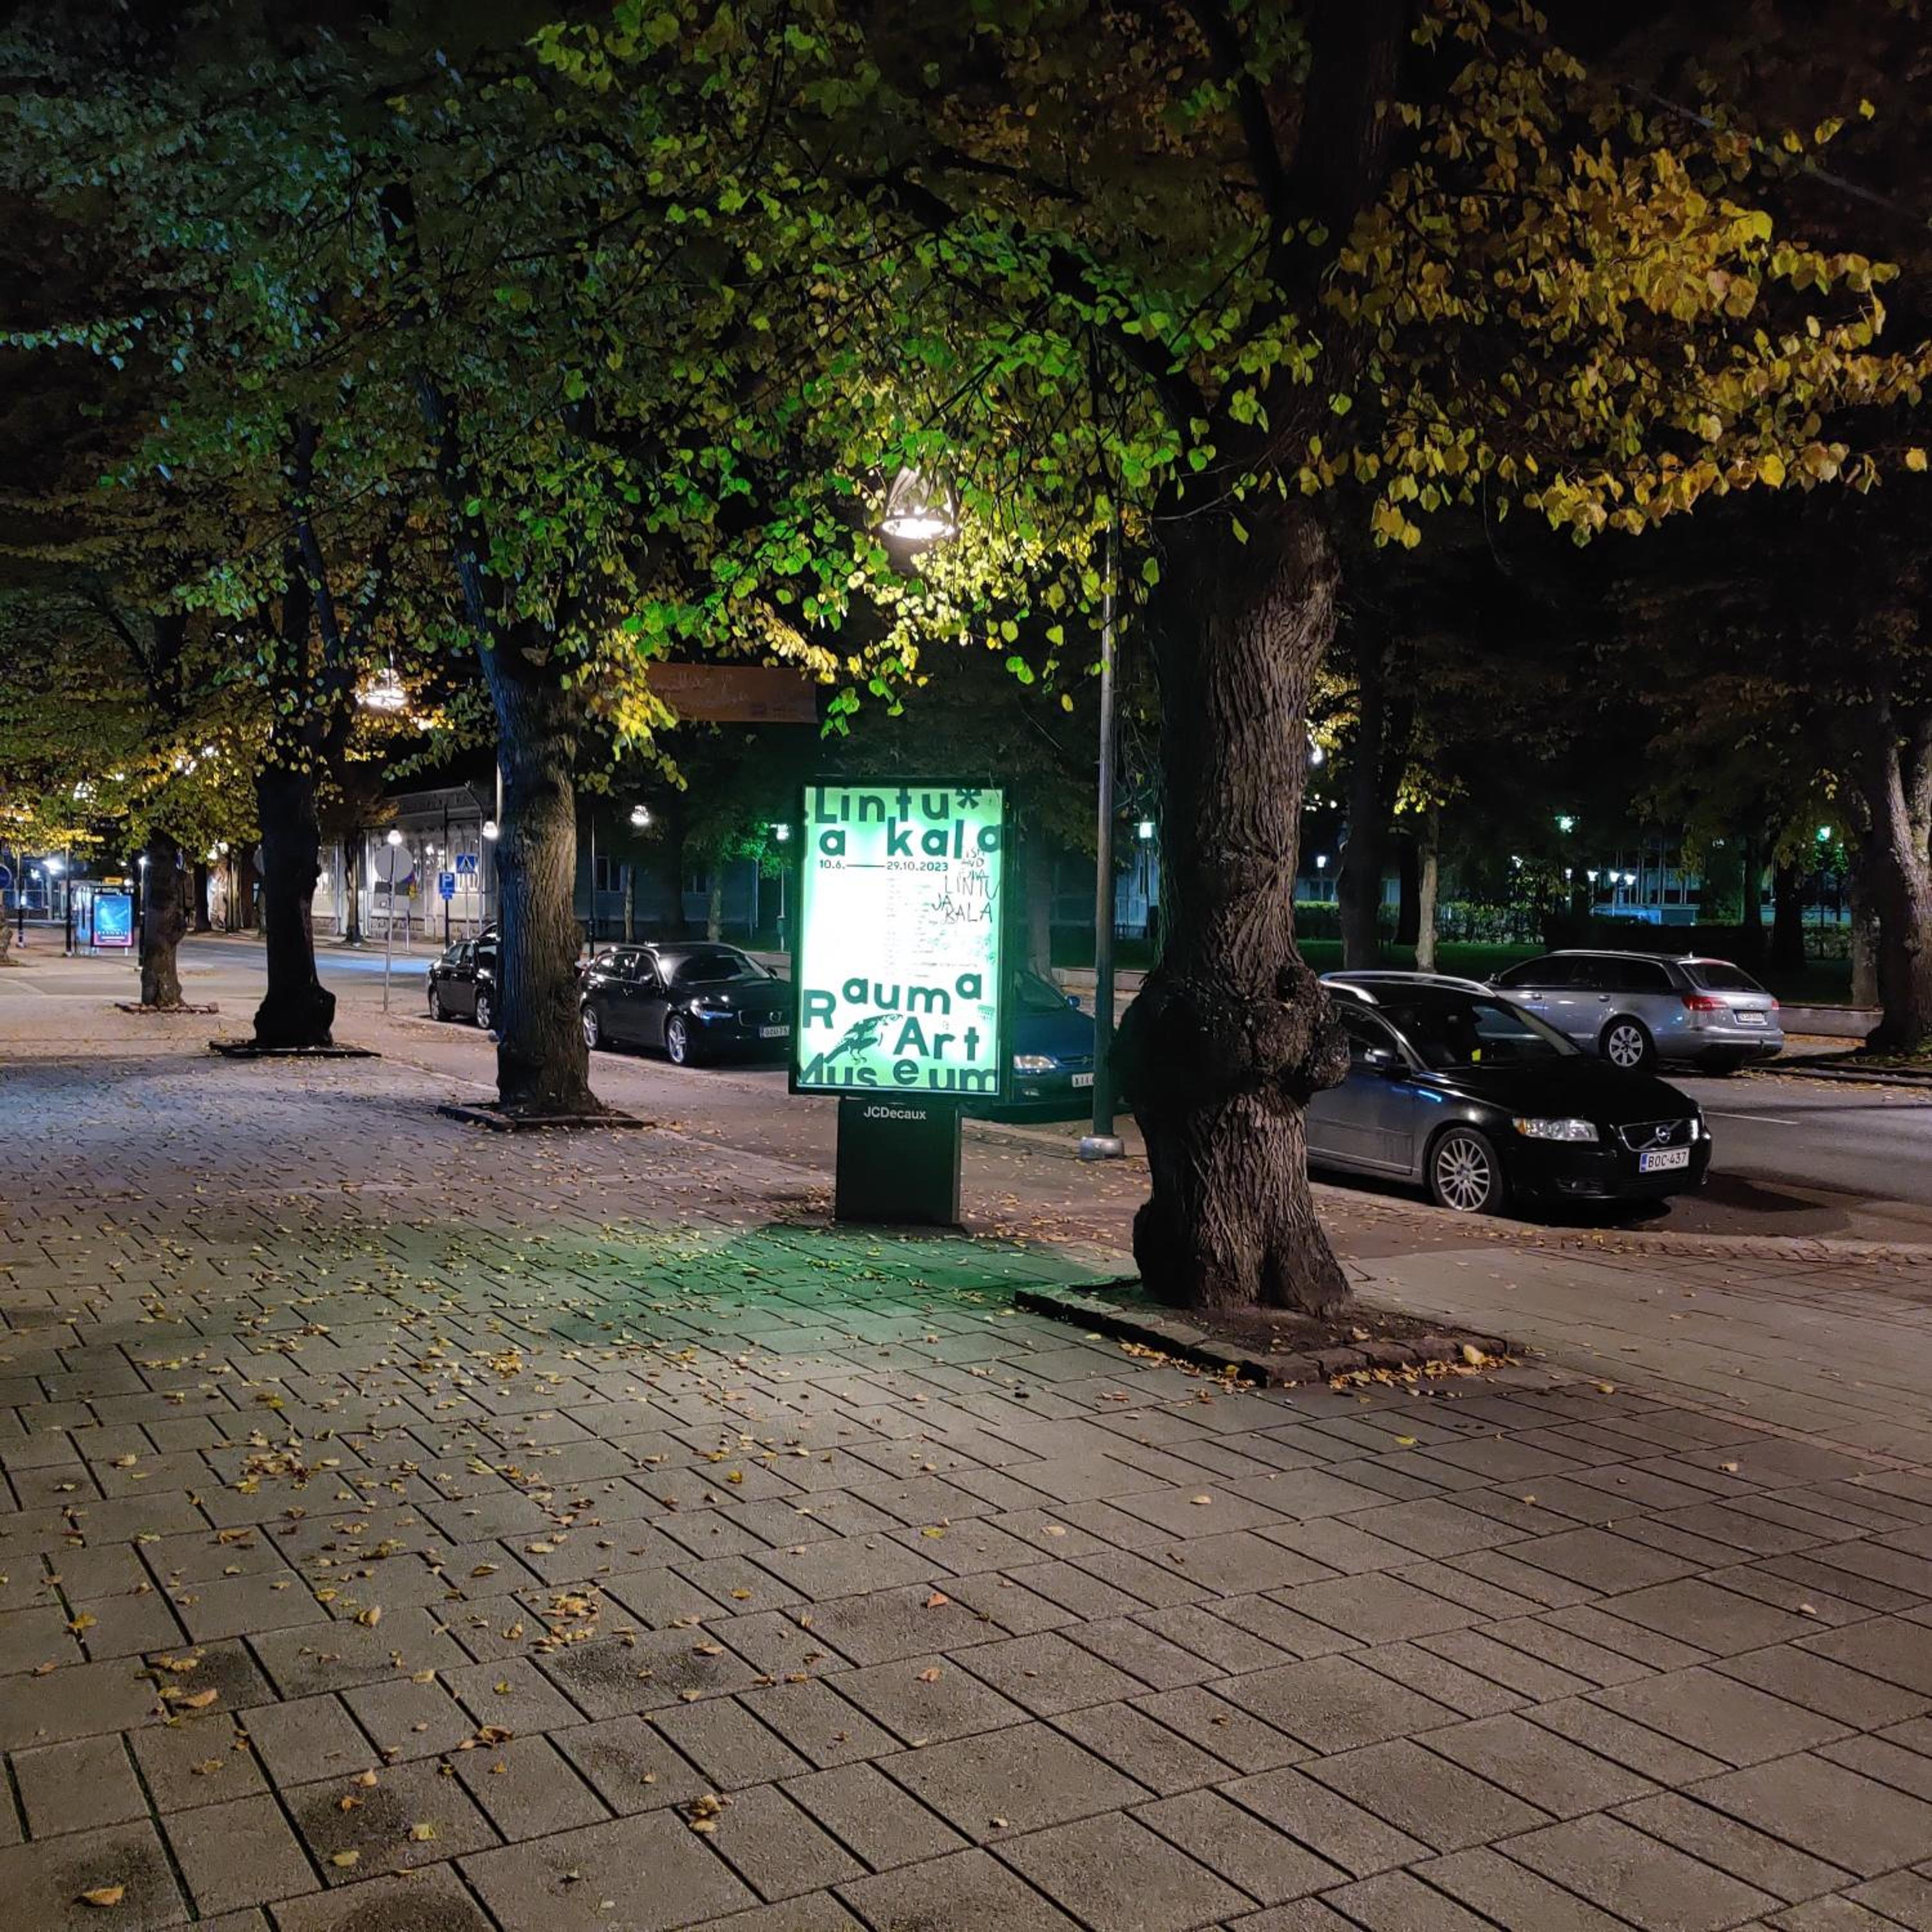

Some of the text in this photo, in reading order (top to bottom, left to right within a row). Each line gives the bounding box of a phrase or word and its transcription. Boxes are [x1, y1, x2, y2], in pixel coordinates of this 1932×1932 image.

[442, 874, 453, 887] P
[944, 875, 1000, 900] LINTU
[802, 972, 982, 1028] Rauma
[893, 1016, 980, 1061] Art
[864, 1105, 927, 1120] JCDecaux
[1649, 1151, 1687, 1168] BOC-437
